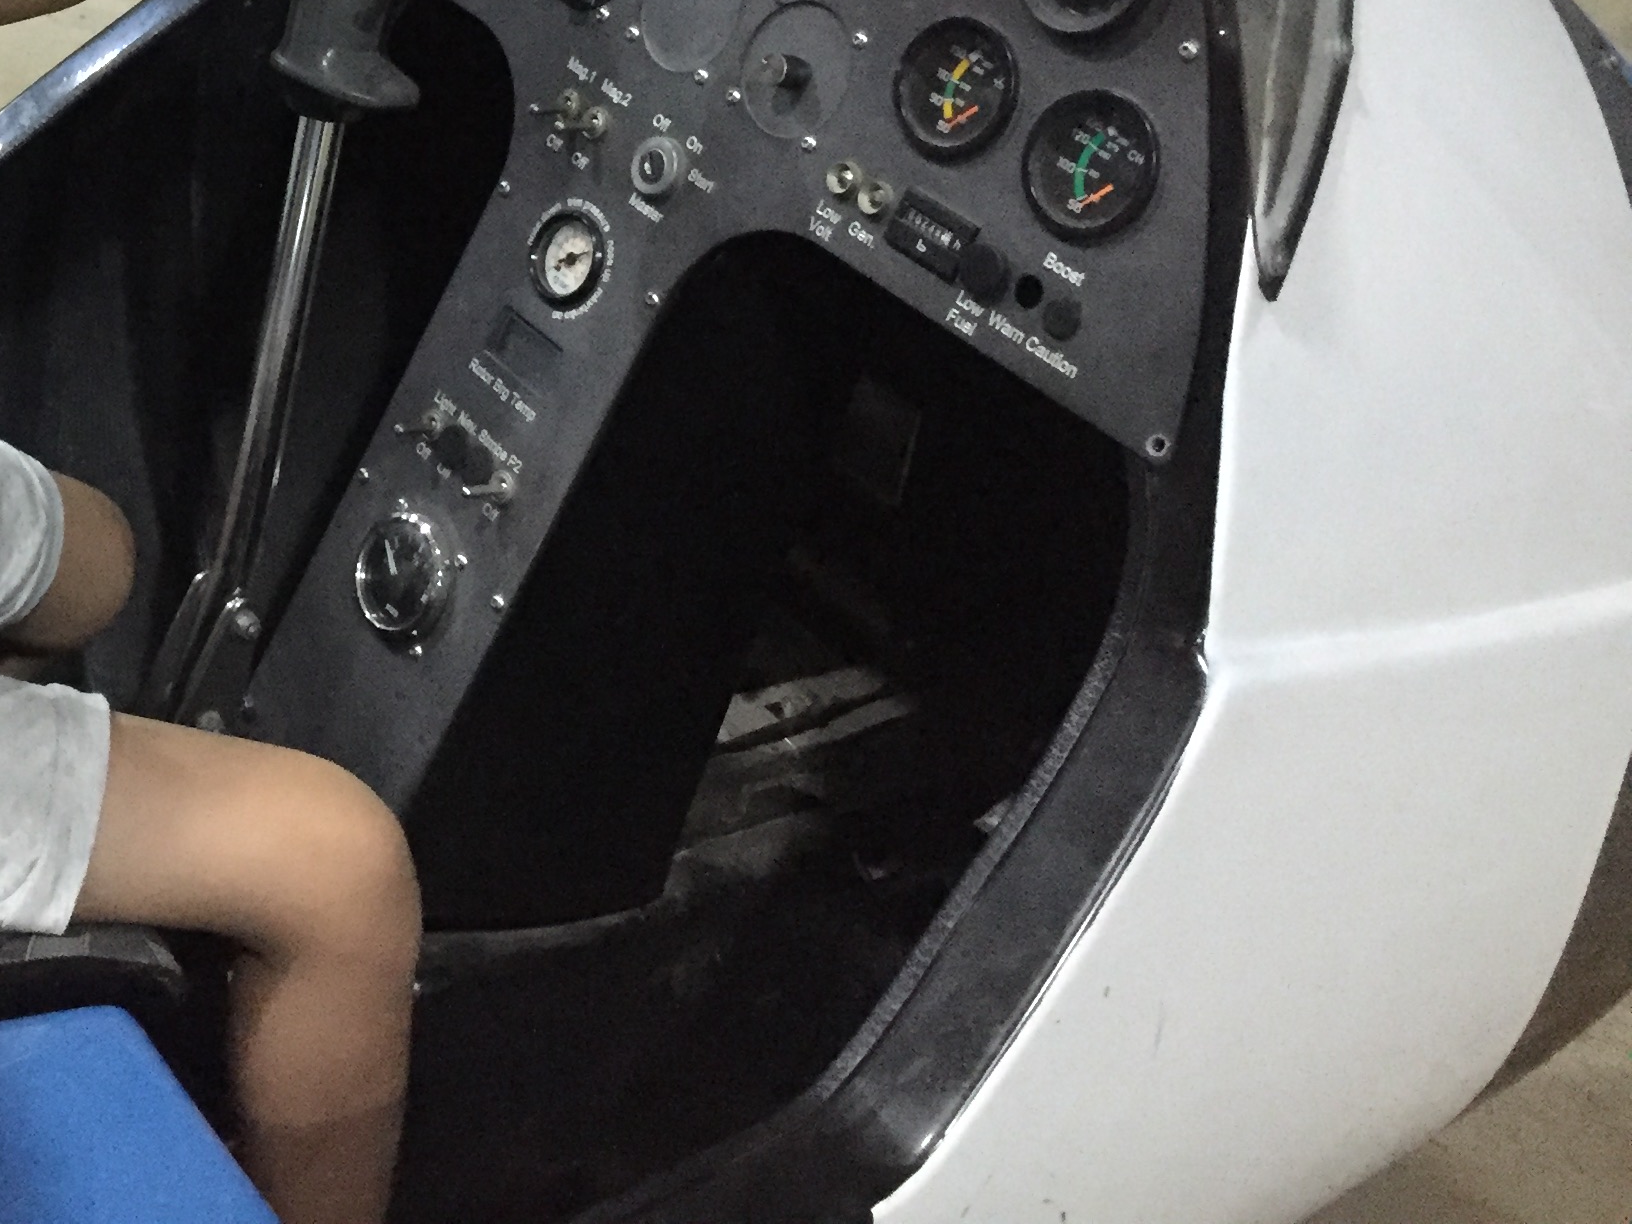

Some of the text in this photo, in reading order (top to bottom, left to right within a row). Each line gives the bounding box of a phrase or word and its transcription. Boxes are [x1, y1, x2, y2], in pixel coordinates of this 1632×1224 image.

[686, 135, 703, 155] On
[816, 199, 842, 225] Low
[809, 215, 833, 242] Volt
[1042, 251, 1086, 287] Boost
[945, 307, 978, 337] Fuel
[955, 289, 986, 317] Low
[1025, 336, 1079, 379] Caution
